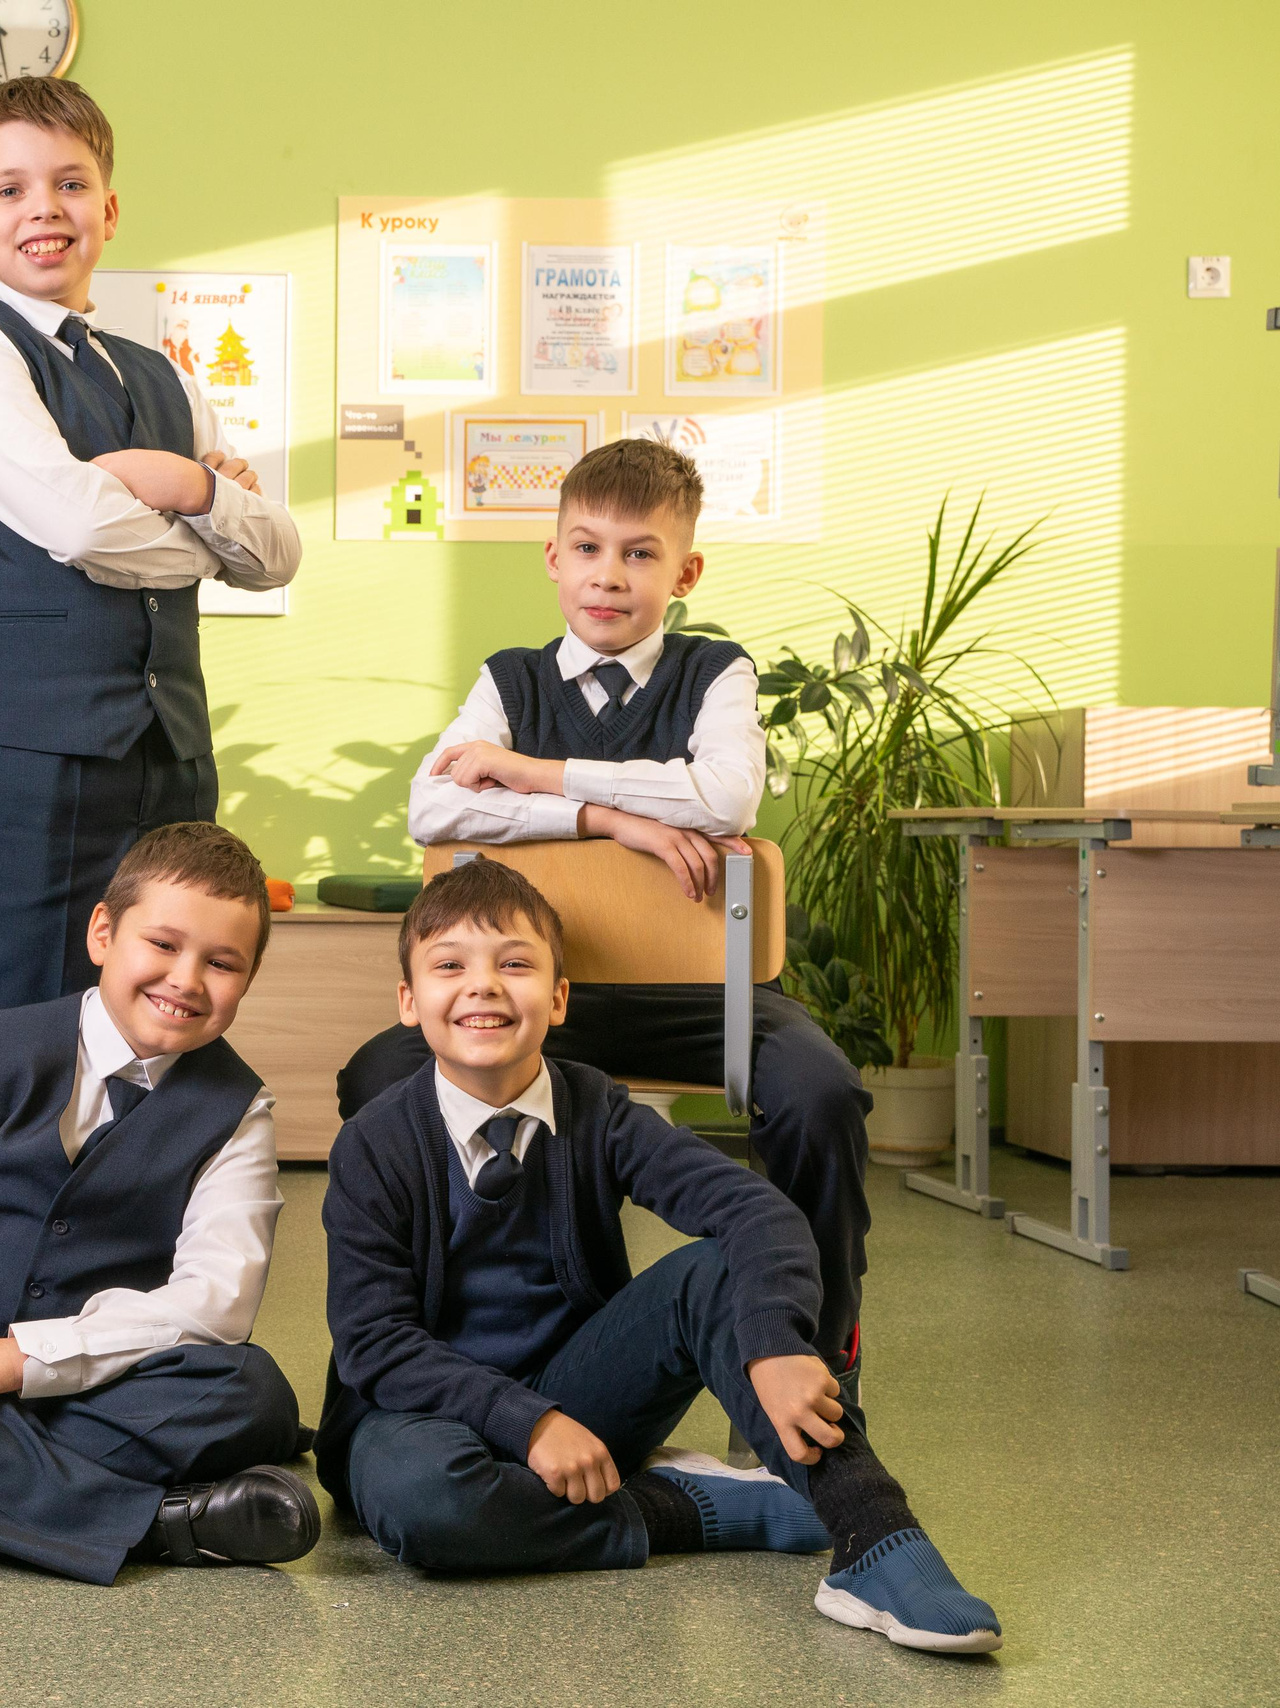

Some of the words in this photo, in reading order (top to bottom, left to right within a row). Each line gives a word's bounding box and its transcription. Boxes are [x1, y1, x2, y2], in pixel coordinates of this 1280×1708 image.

[48, 19, 61, 38] 3
[38, 46, 51, 64] 4
[361, 212, 373, 228] К
[379, 217, 439, 233] уроку
[535, 267, 621, 287] ГРАМОТА
[172, 290, 188, 304] 14
[193, 294, 246, 308] января
[542, 293, 616, 301] НАГРАЖДАЕТСЯ
[344, 410, 378, 420] Что-то
[480, 433, 501, 443] Мы
